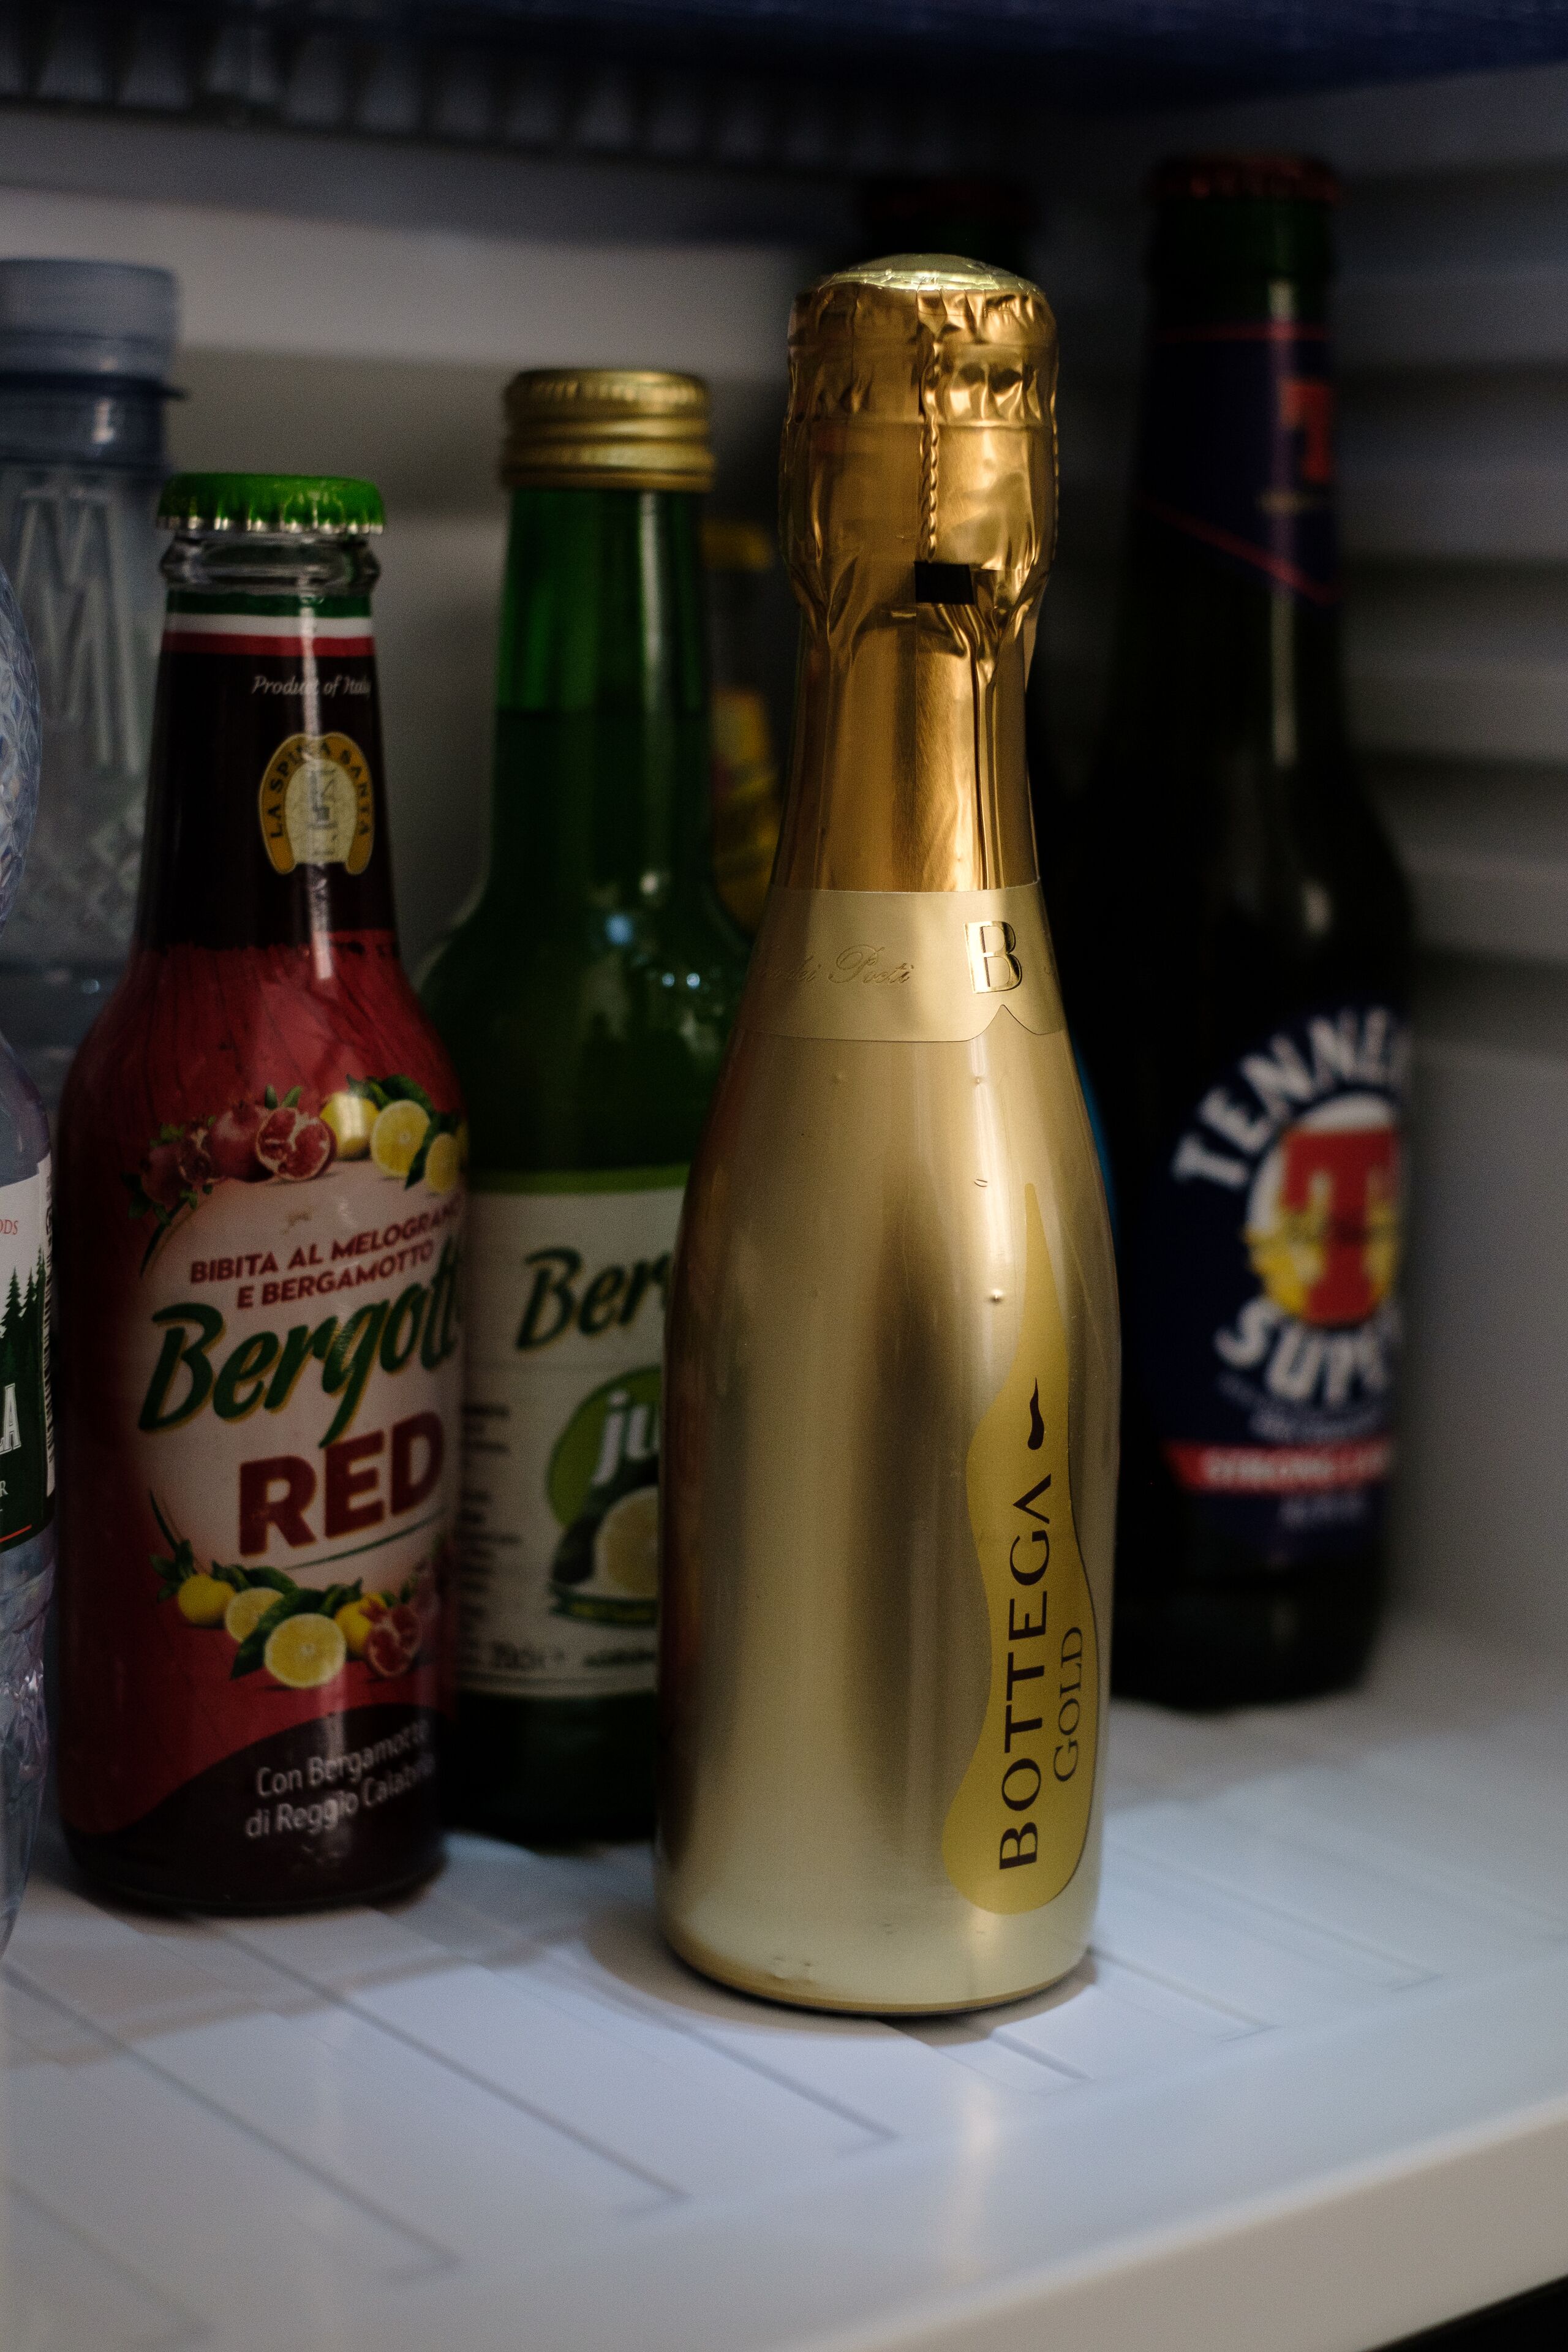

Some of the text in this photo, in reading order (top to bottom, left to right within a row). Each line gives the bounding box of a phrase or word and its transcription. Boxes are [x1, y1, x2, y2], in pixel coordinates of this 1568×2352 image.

[323, 673, 343, 698] of
[268, 804, 283, 839] LA
[964, 920, 1023, 994] B
[190, 1251, 278, 1283] BIBITA
[287, 1242, 323, 1270] AL
[236, 1238, 434, 1309] E BERGAMOTTO
[516, 1247, 669, 1350] Ber
[592, 1387, 661, 1487] ju
[239, 1411, 443, 1556] RED
[999, 1472, 1052, 1870] BOTTEGA
[1053, 1626, 1084, 1782] GOLD
[255, 1765, 304, 1800] Con
[245, 1807, 271, 1838] di
